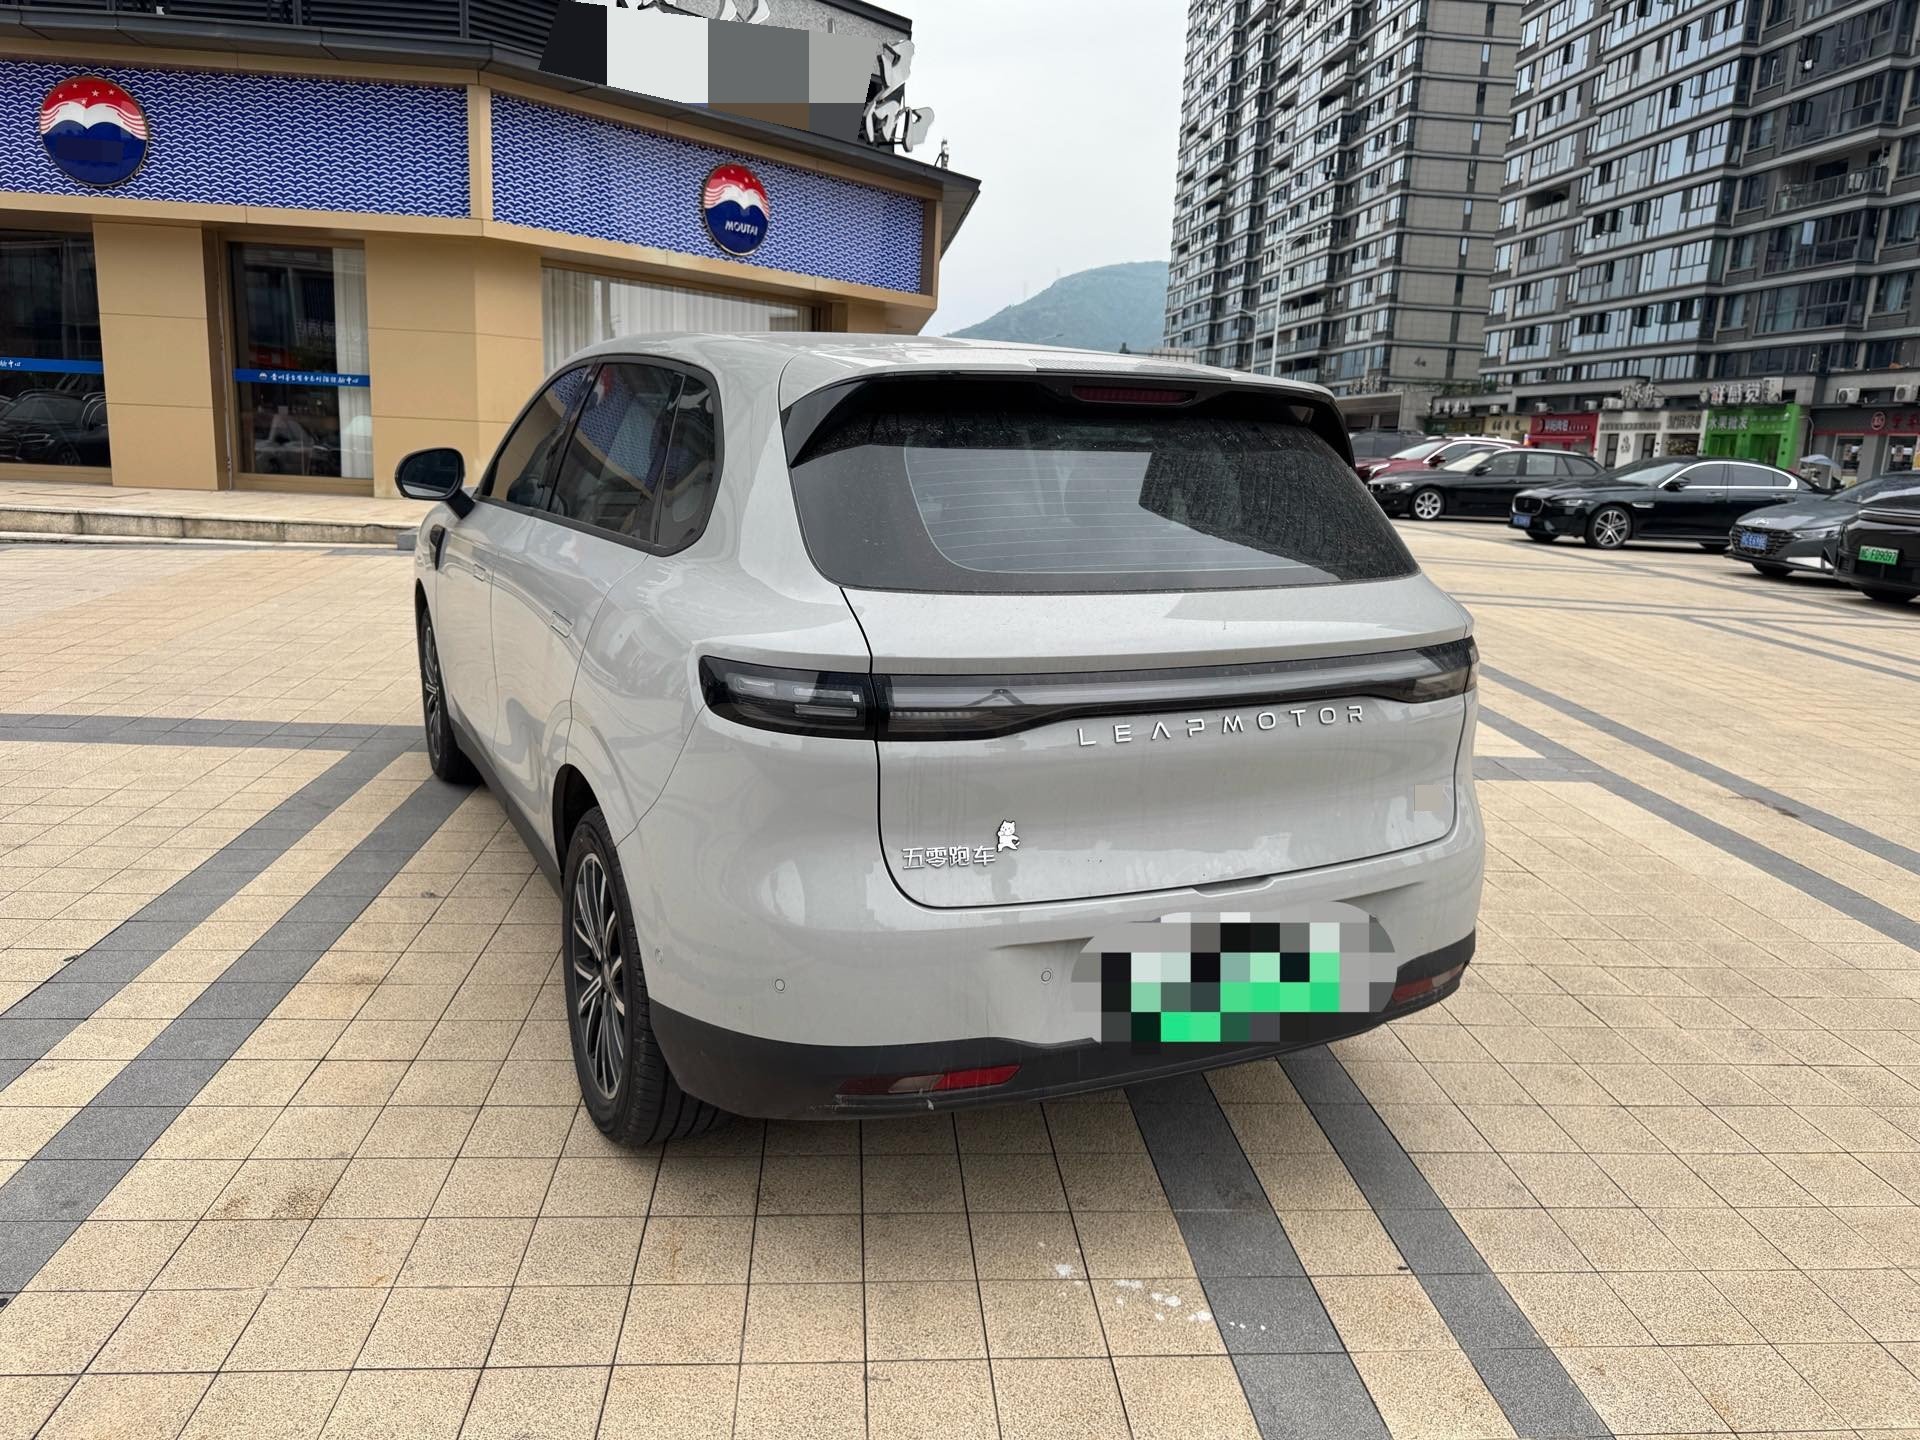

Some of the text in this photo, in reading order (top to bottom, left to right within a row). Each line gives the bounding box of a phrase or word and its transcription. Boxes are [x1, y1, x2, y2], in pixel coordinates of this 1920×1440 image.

[725, 220, 758, 236] MOUTAI
[1077, 705, 1364, 746] LEAPMOTOR
[902, 845, 996, 870] 五零跑车
